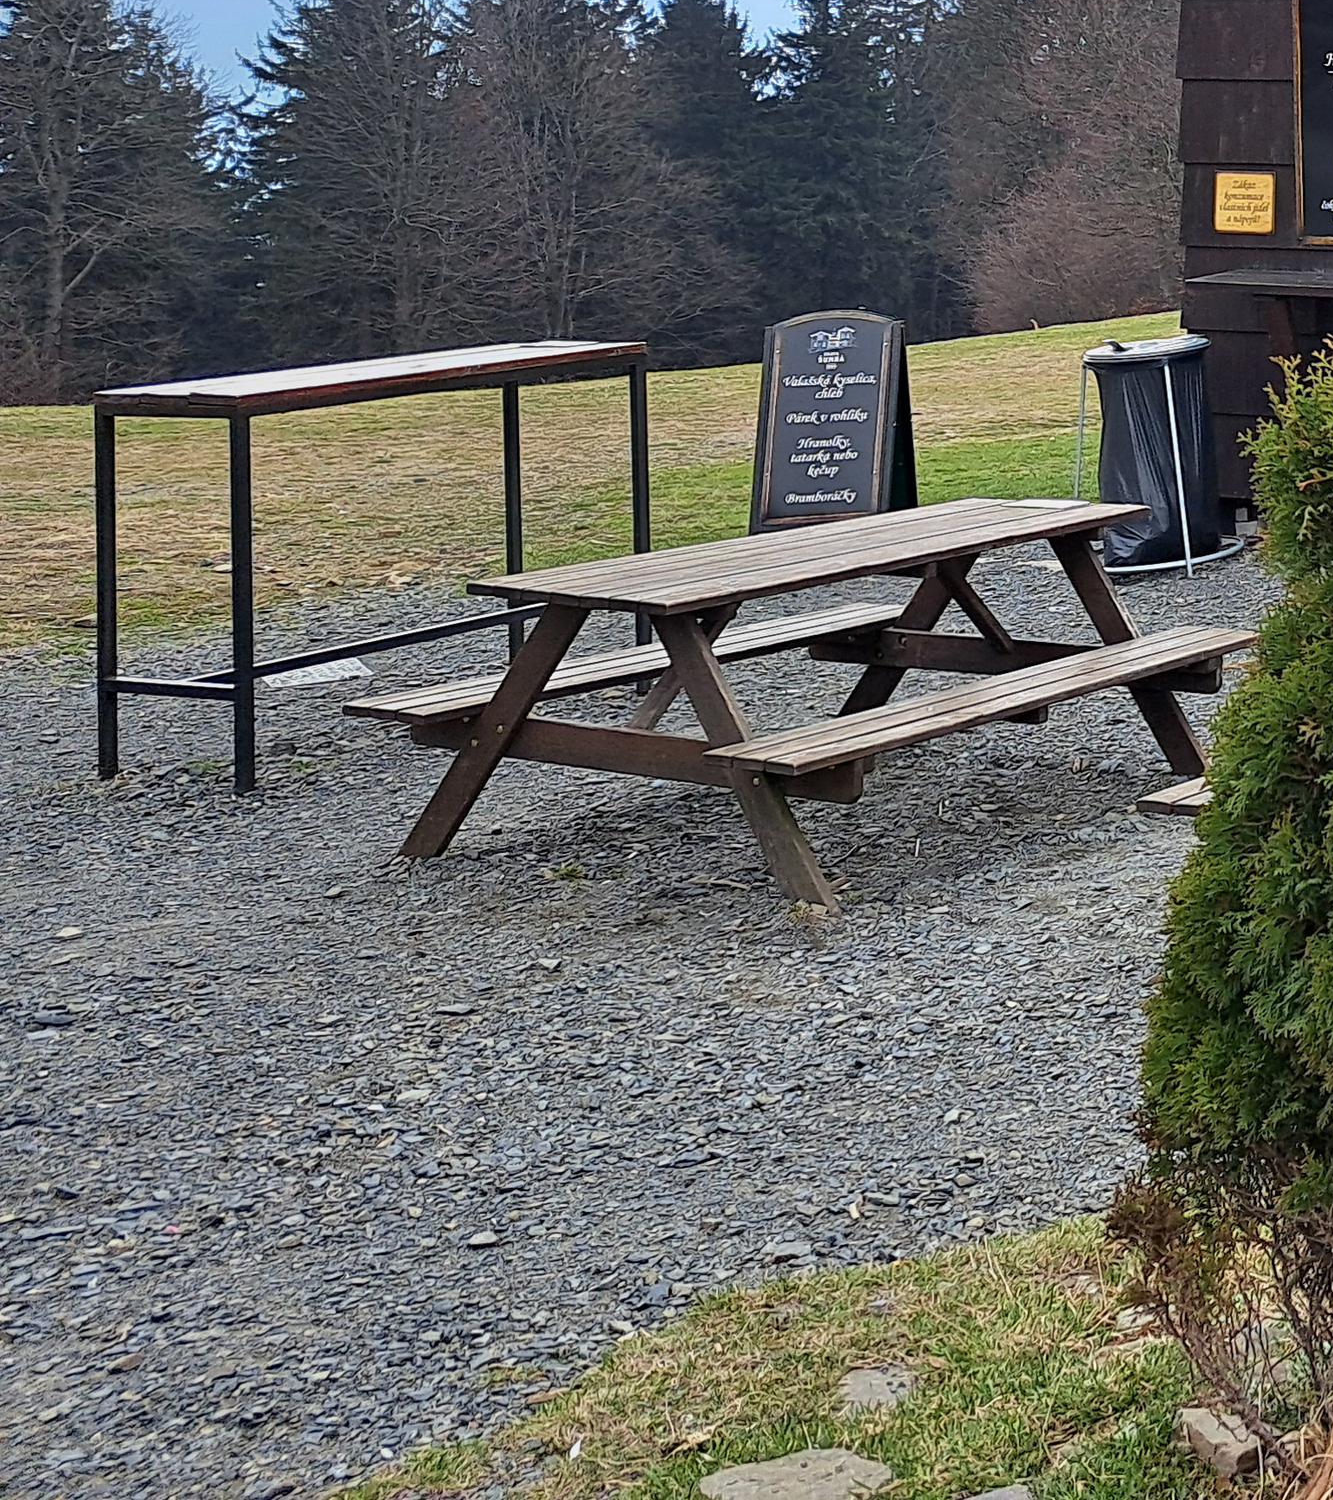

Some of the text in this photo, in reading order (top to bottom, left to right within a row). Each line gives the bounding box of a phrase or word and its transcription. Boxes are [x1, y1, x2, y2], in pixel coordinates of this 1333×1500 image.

[786, 410, 820, 424] Párek
[819, 413, 829, 422] v
[789, 448, 859, 463] tatarka nebo
[806, 463, 840, 478] kečup
